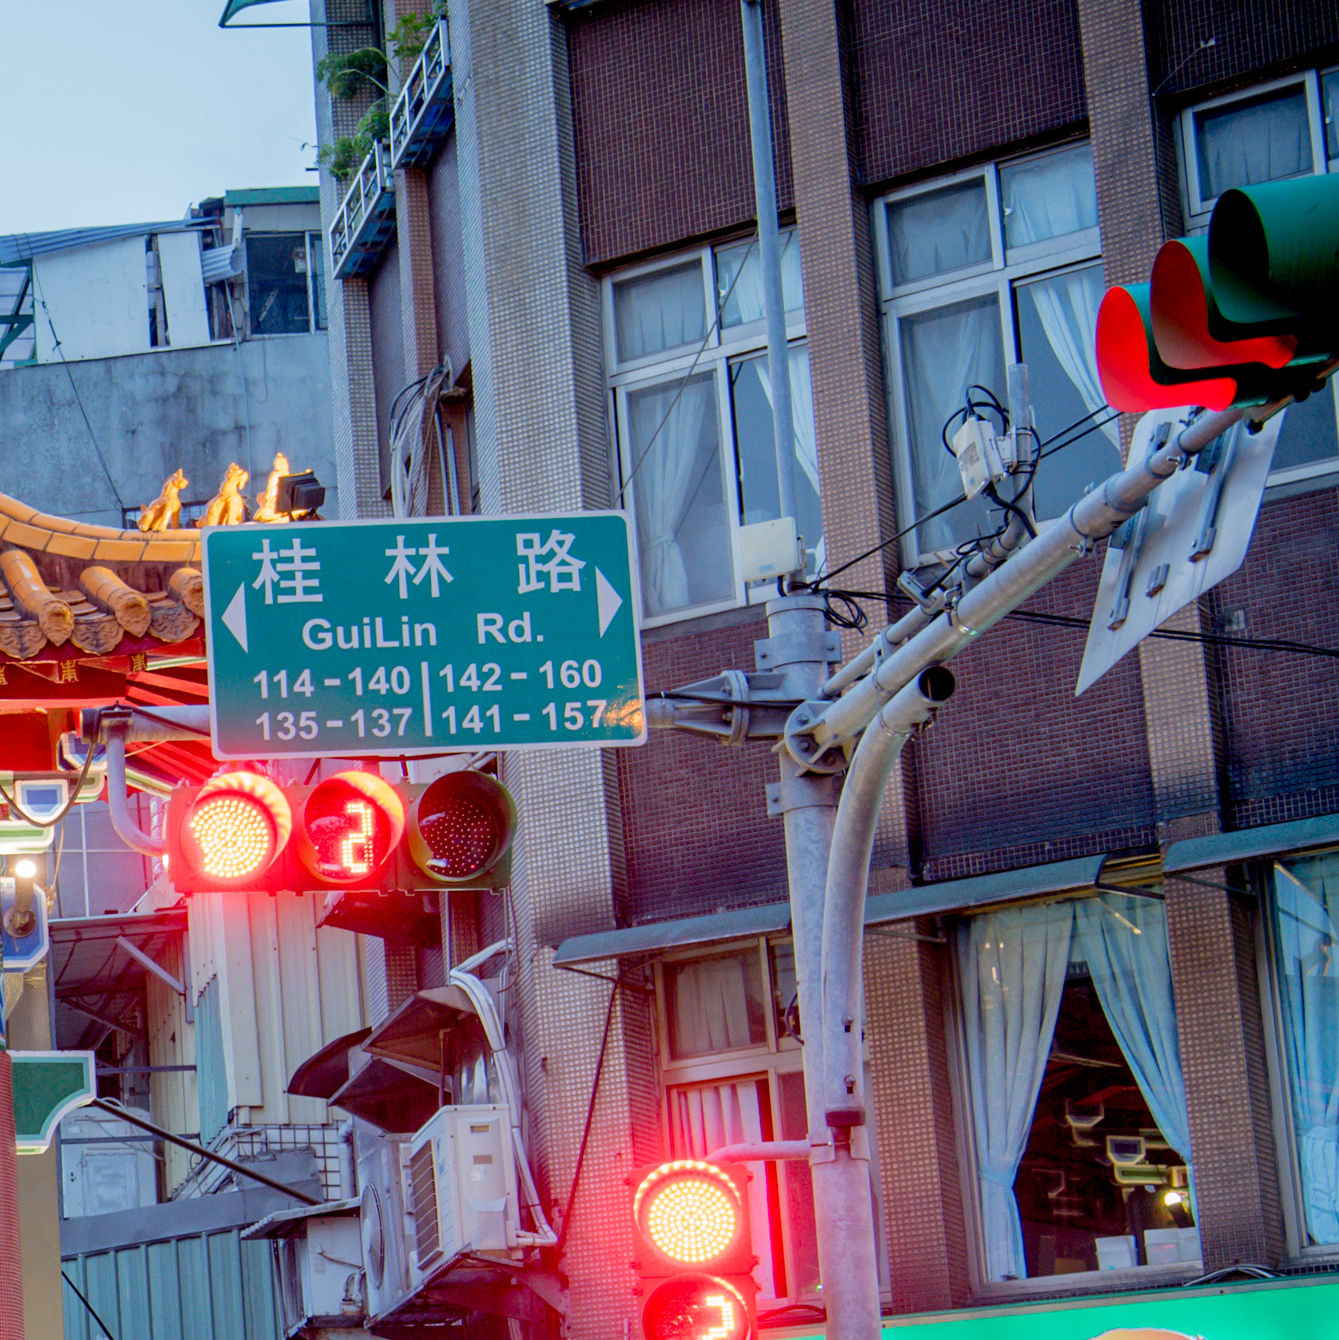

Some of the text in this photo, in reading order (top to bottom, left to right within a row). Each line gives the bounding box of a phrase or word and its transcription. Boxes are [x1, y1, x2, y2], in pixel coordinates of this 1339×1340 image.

[252, 529, 586, 604] 桂林路
[302, 612, 544, 650] GuiLin Rd.
[342, 802, 374, 874] 2
